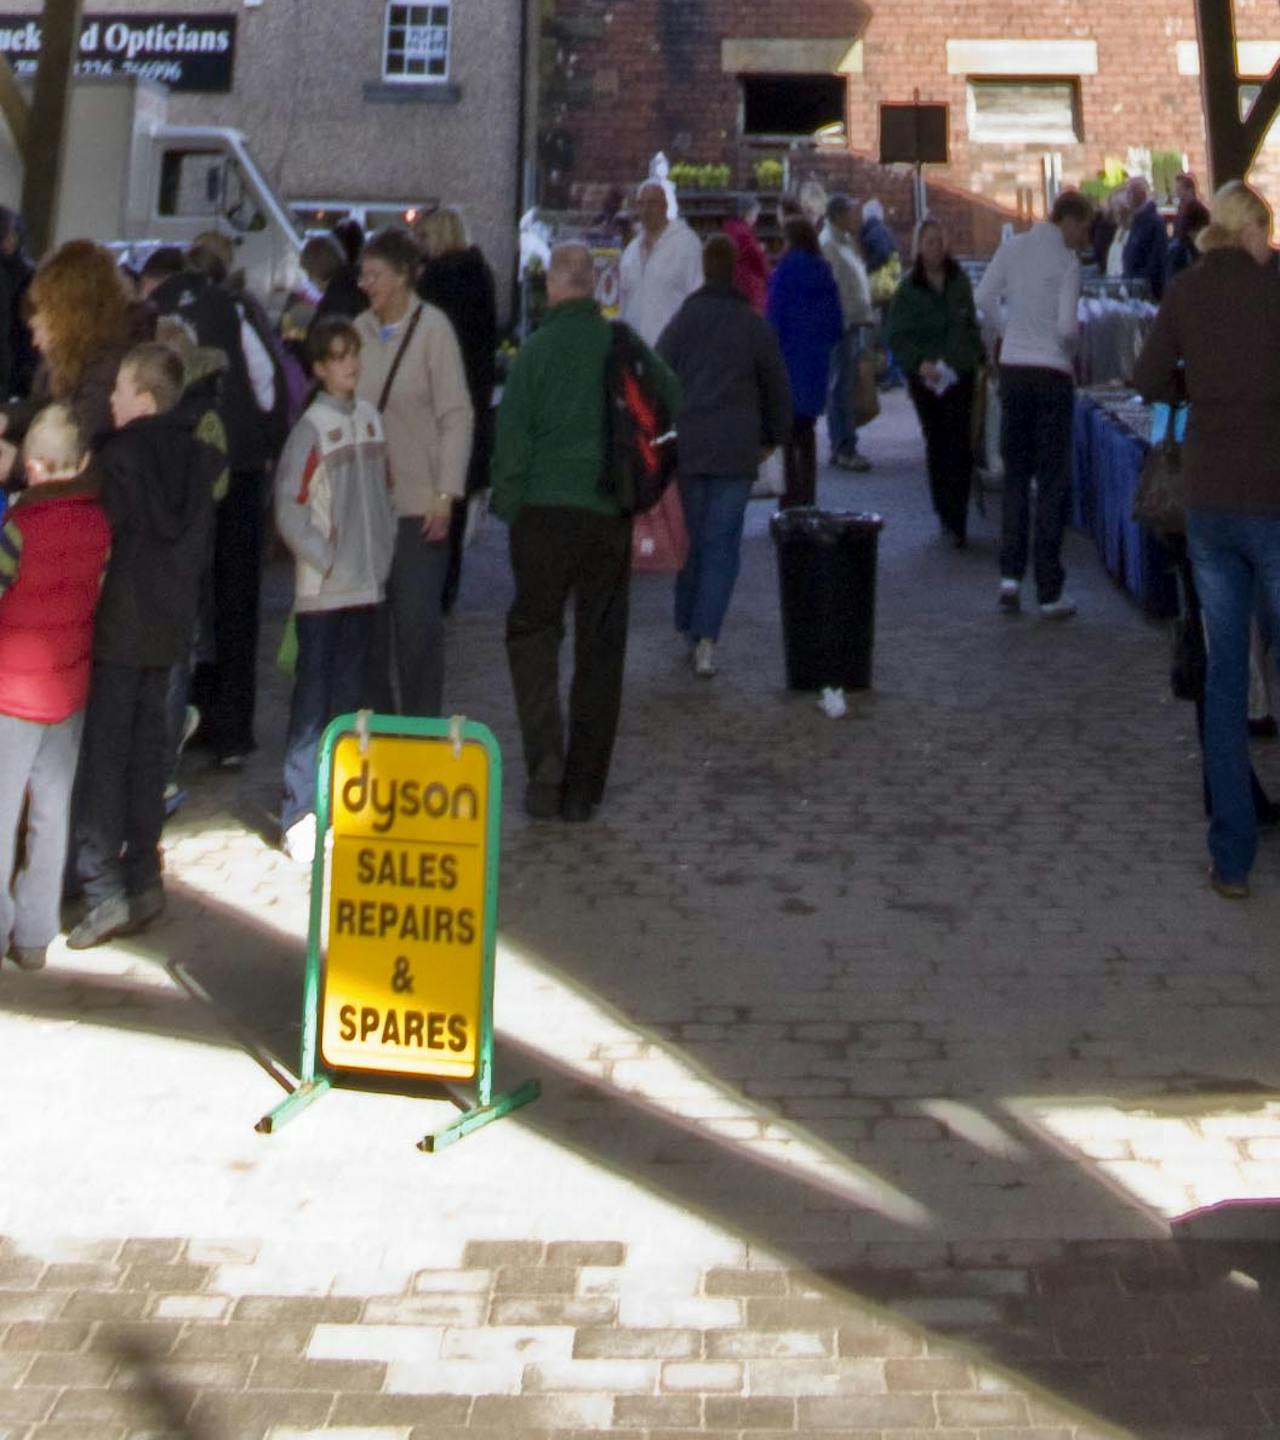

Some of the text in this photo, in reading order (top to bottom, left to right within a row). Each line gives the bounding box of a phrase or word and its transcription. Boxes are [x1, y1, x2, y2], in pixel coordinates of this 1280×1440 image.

[104, 22, 230, 59] Opticians
[73, 60, 112, 76] 1226
[341, 759, 478, 833] dyson
[356, 848, 458, 890] SALES
[336, 898, 476, 946] REPAIRS
[391, 955, 415, 994] &
[338, 1004, 468, 1053] SPARES
